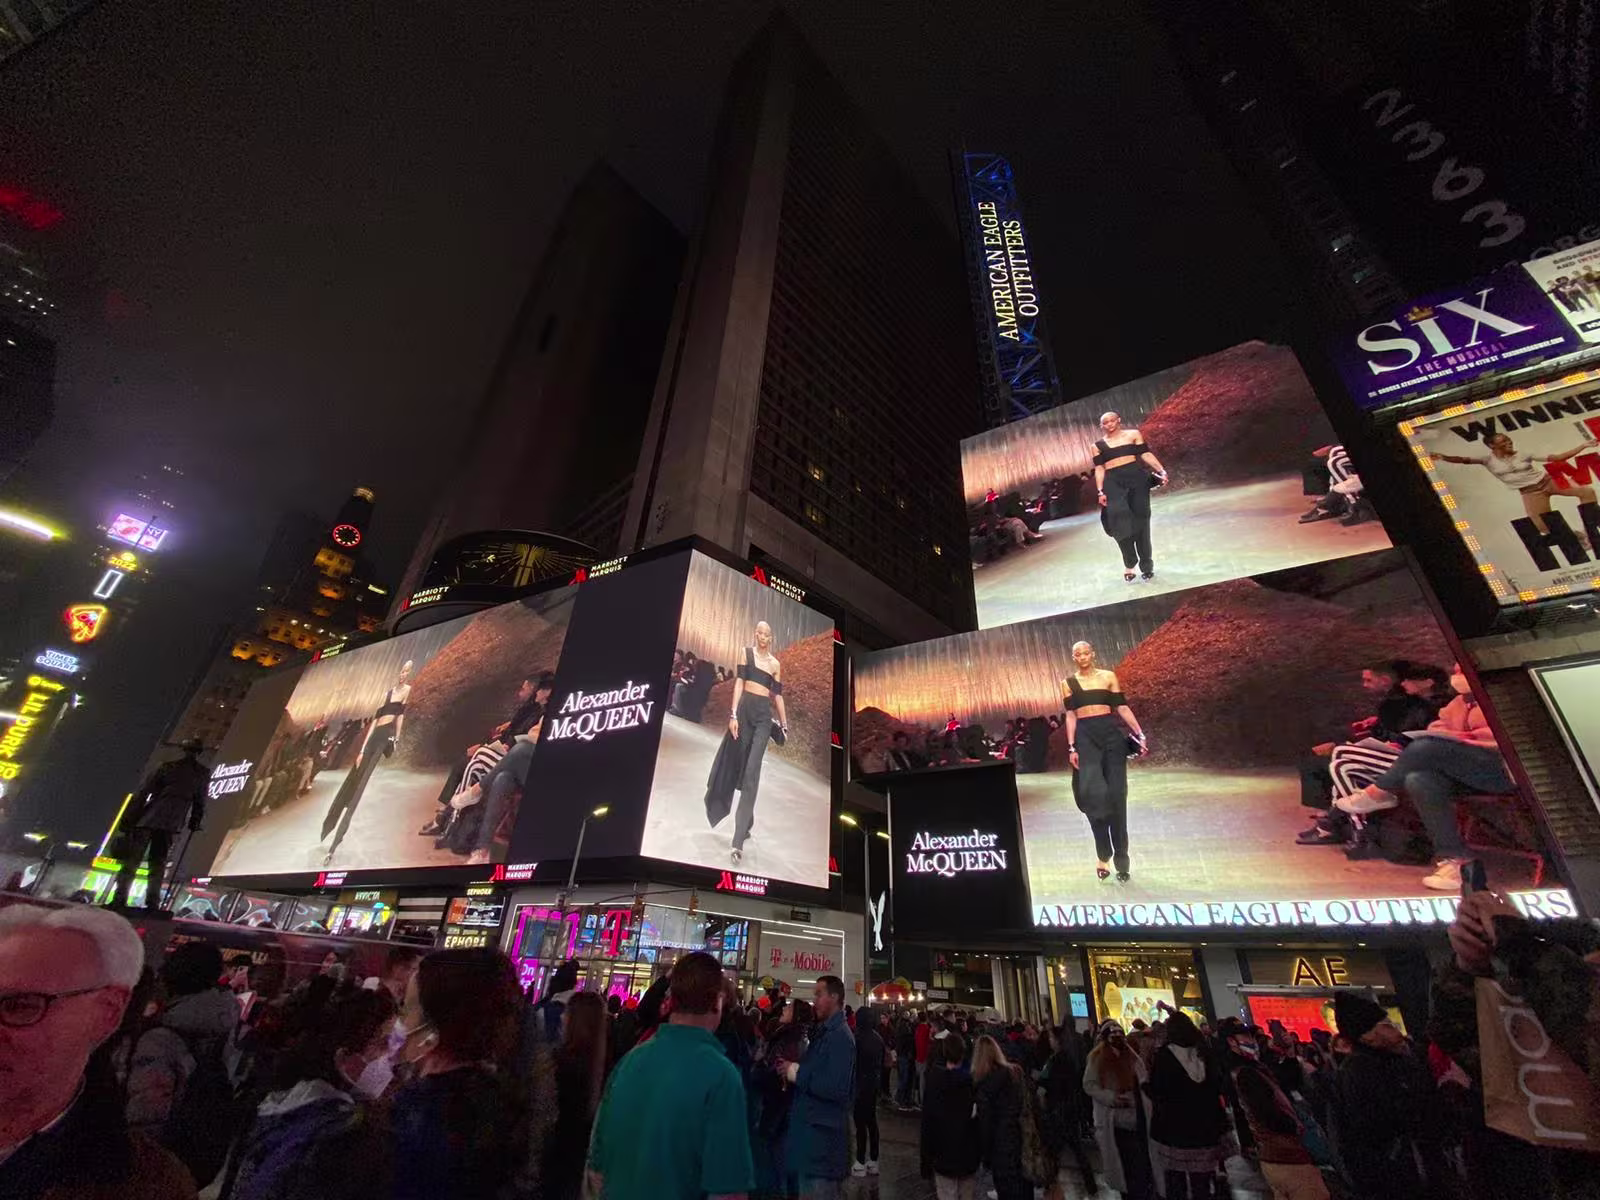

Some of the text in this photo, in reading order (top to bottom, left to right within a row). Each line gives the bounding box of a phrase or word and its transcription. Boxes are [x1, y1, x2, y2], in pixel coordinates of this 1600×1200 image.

[978, 201, 1020, 342] AMERICAN EAGLE
[1002, 220, 1039, 317] OUTFITTERS
[1357, 287, 1538, 376] SIX
[1415, 342, 1508, 375] THE MUSICAL
[589, 564, 622, 578] MARQUIS
[591, 555, 628, 571] MARRIOTT
[412, 586, 450, 599] MARRIOTT
[770, 575, 806, 597] MARRIOTT
[770, 582, 801, 602] MARQUIS
[410, 594, 441, 606] MARQUIS
[36, 655, 79, 673] SQUARE
[47, 650, 78, 664] TIMES
[558, 680, 650, 714] Alexander
[547, 701, 655, 740] McQUEEN
[911, 829, 999, 850] Alexander
[906, 849, 1007, 877] McQUEEN
[735, 881, 765, 893] MARQUIS
[736, 874, 769, 886] MARRIOTT
[1038, 903, 1199, 927] AMERICAN
[1204, 901, 1316, 926] EAGLE
[605, 909, 632, 956] T
[1292, 956, 1353, 987] AE
